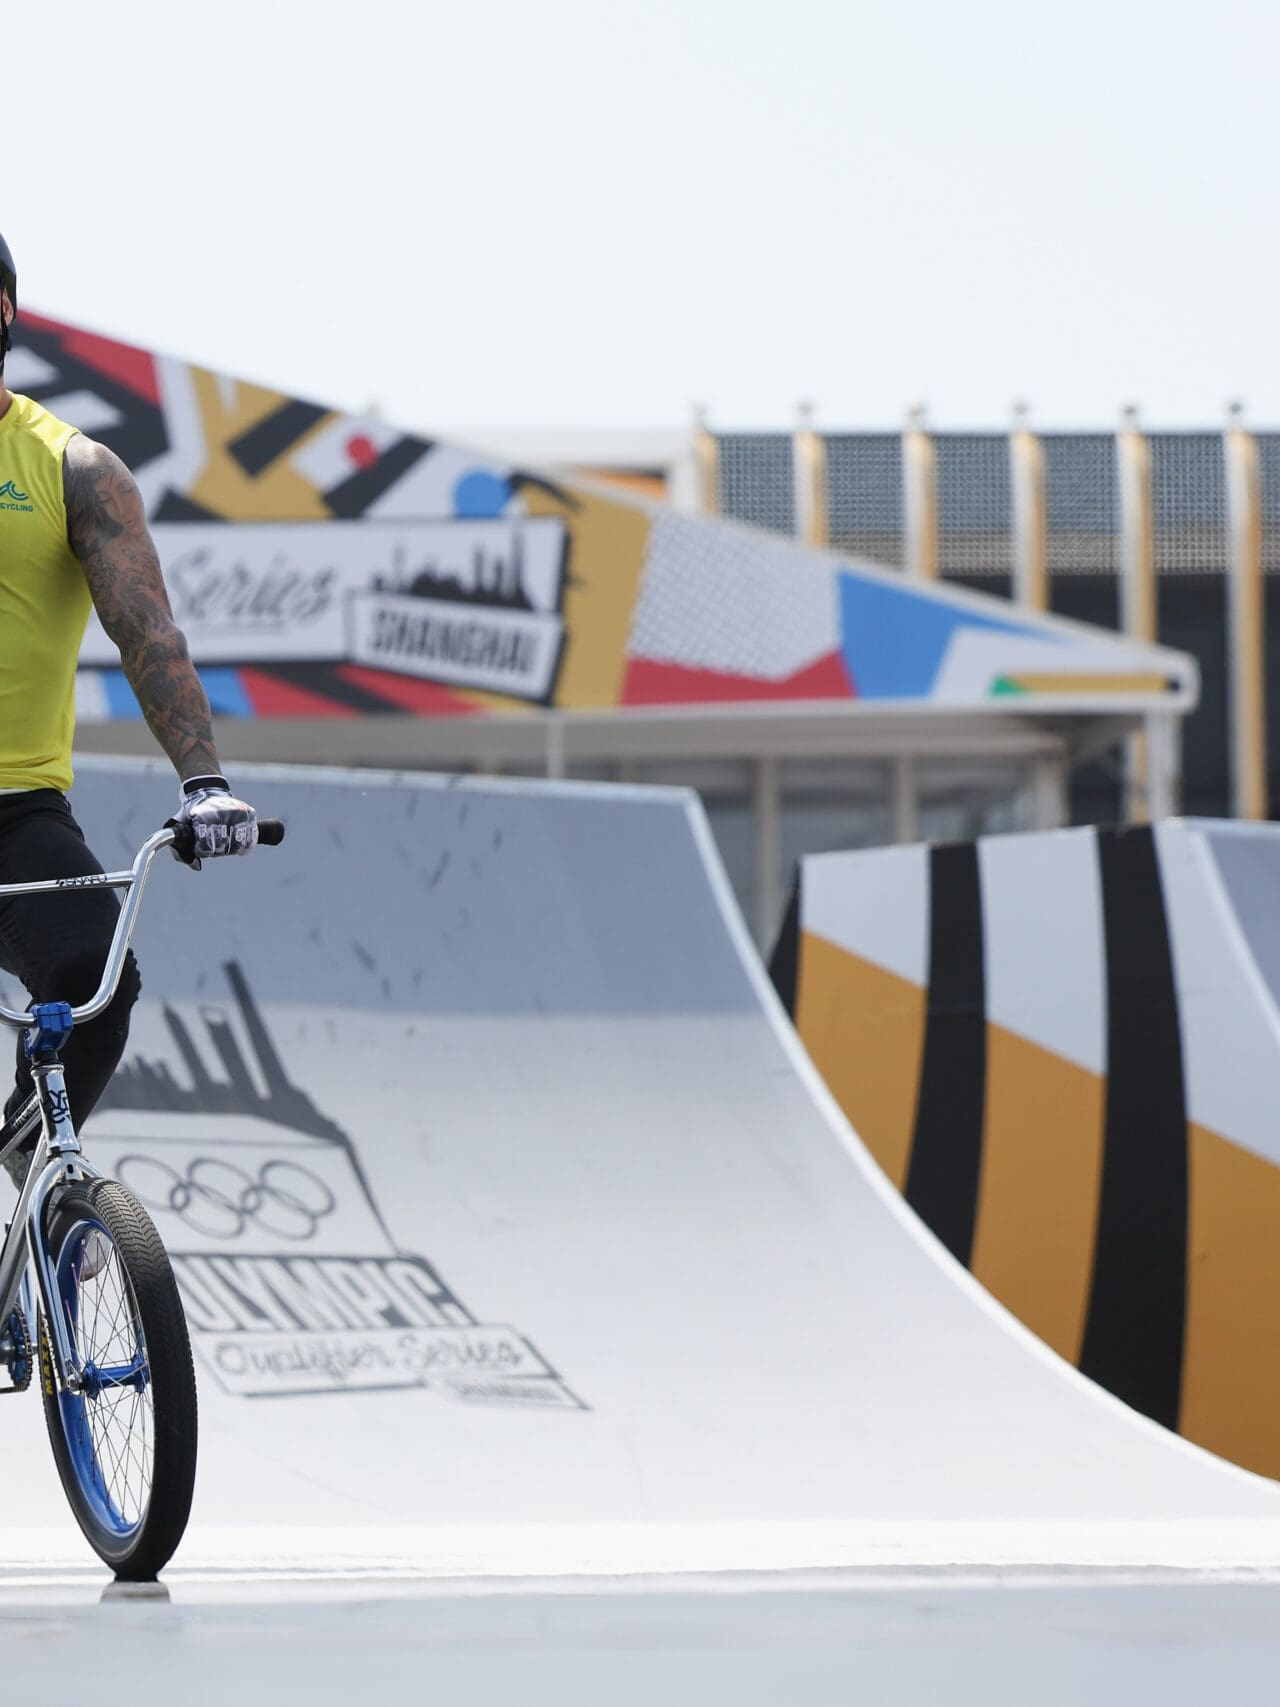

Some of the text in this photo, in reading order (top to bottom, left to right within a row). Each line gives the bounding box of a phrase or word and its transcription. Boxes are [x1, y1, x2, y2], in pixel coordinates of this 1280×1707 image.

[167, 546, 336, 621] Series
[371, 608, 538, 674] SHANGHAI
[397, 1334, 522, 1370] Series
